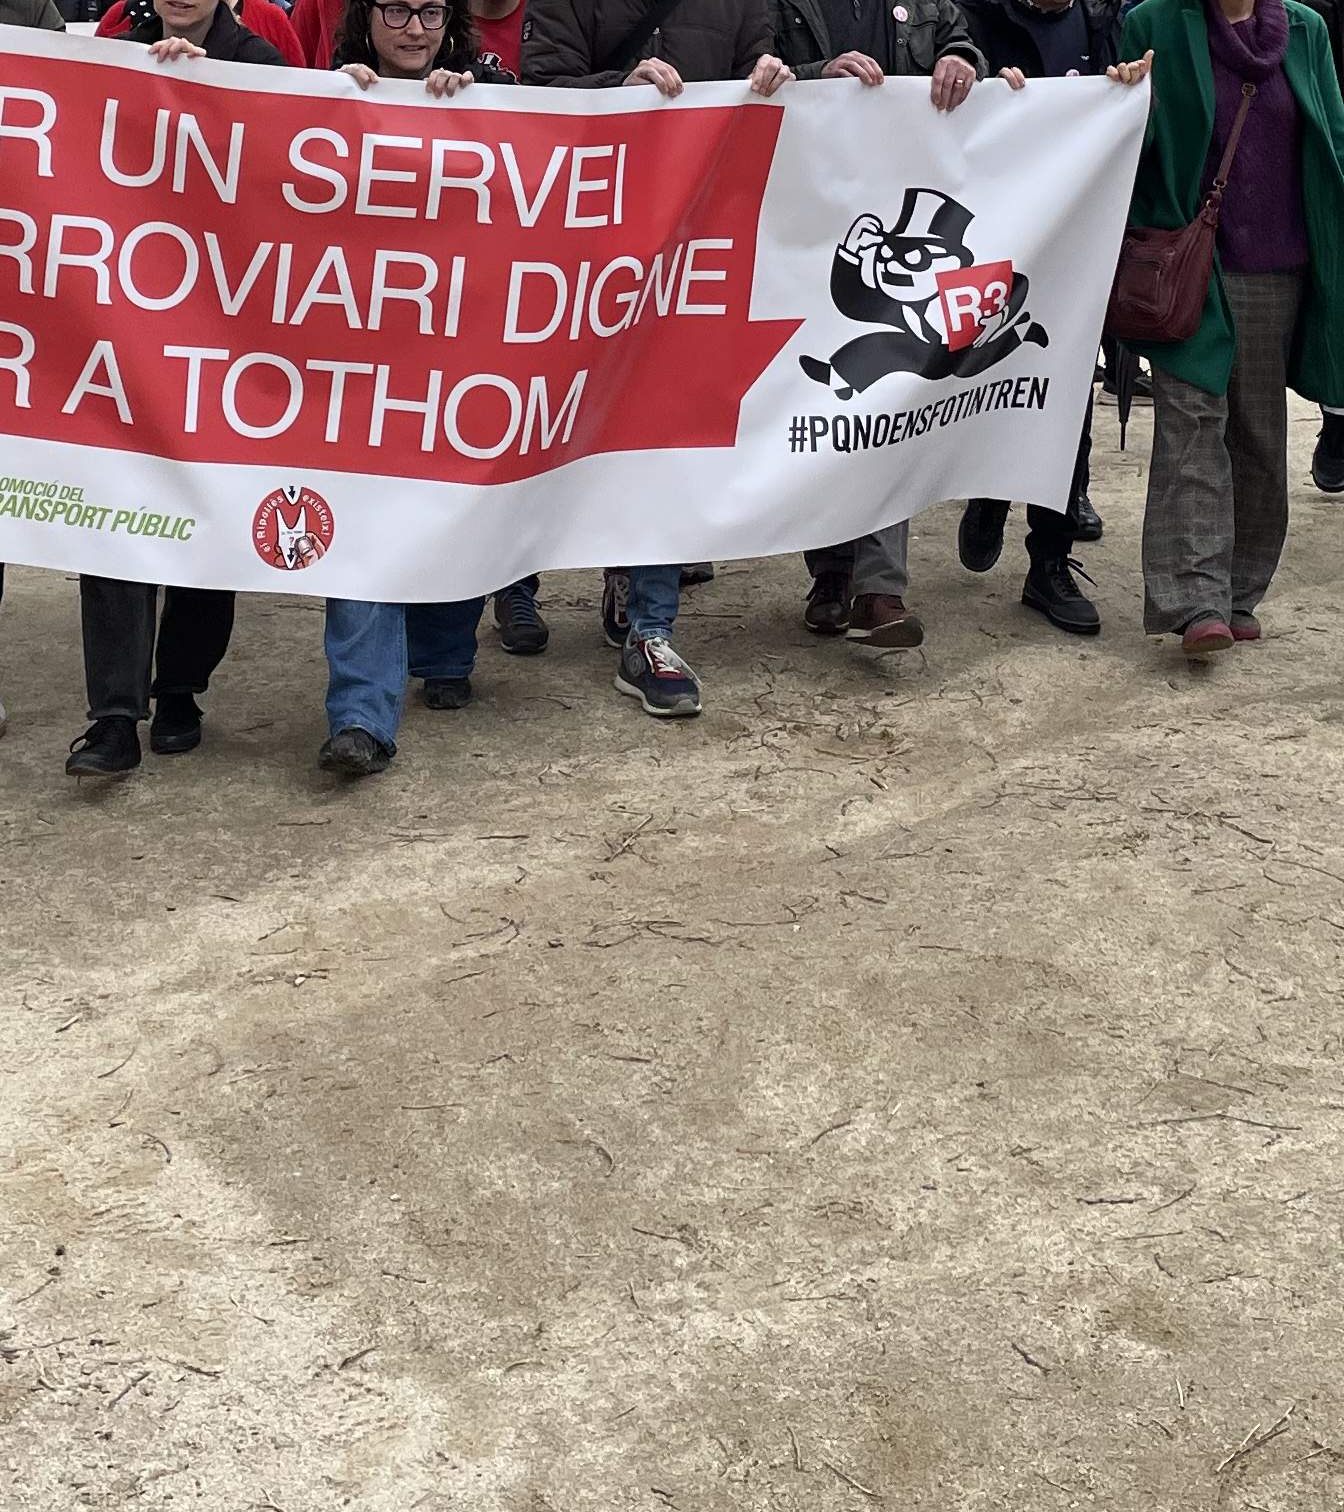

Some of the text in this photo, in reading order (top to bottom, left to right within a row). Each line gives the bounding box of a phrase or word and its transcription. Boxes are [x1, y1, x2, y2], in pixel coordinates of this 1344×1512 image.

[100, 98, 245, 204] UN
[281, 127, 627, 228] SERVEI
[502, 238, 735, 345] DIGNE
[944, 280, 1009, 331] R3
[61, 339, 135, 424] A
[163, 345, 589, 462] TOTHOM
[788, 376, 1050, 454] #PQNOENSFOTINTREN
[58, 485, 85, 503] DEL
[111, 505, 196, 542] PÚBLIC
